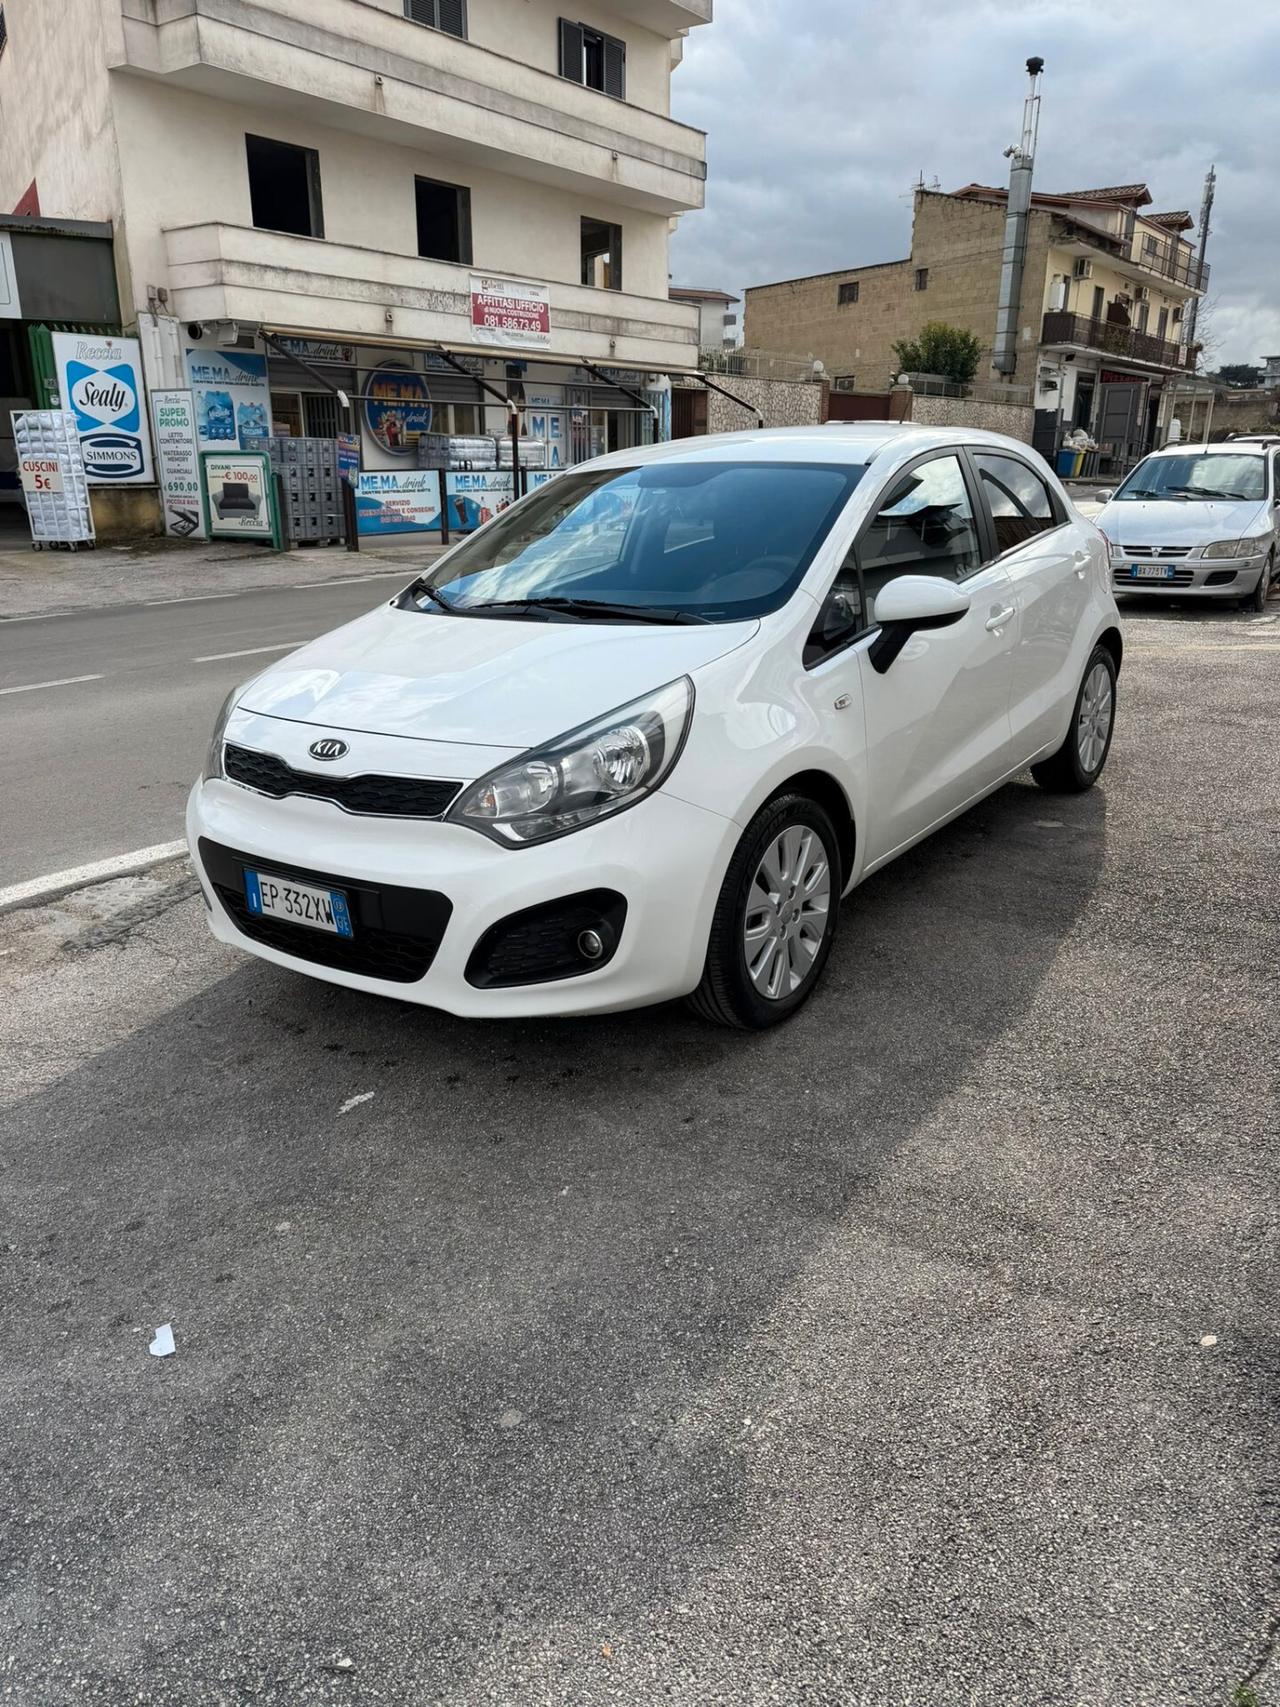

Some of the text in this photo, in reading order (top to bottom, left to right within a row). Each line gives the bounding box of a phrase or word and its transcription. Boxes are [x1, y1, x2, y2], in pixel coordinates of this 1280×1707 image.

[477, 295, 545, 313] AFFITTASI UFFICIO
[79, 381, 126, 412] Sealy
[160, 408, 186, 417] SUPER
[159, 418, 189, 428] PROMO
[86, 450, 137, 461] SIMMONS
[22, 460, 59, 473] CUSCINI
[402, 474, 426, 489] drink
[406, 506, 436, 514] CONSEGNE
[312, 741, 341, 756] KIA
[260, 881, 279, 909] EP
[283, 887, 335, 926] 332XW
